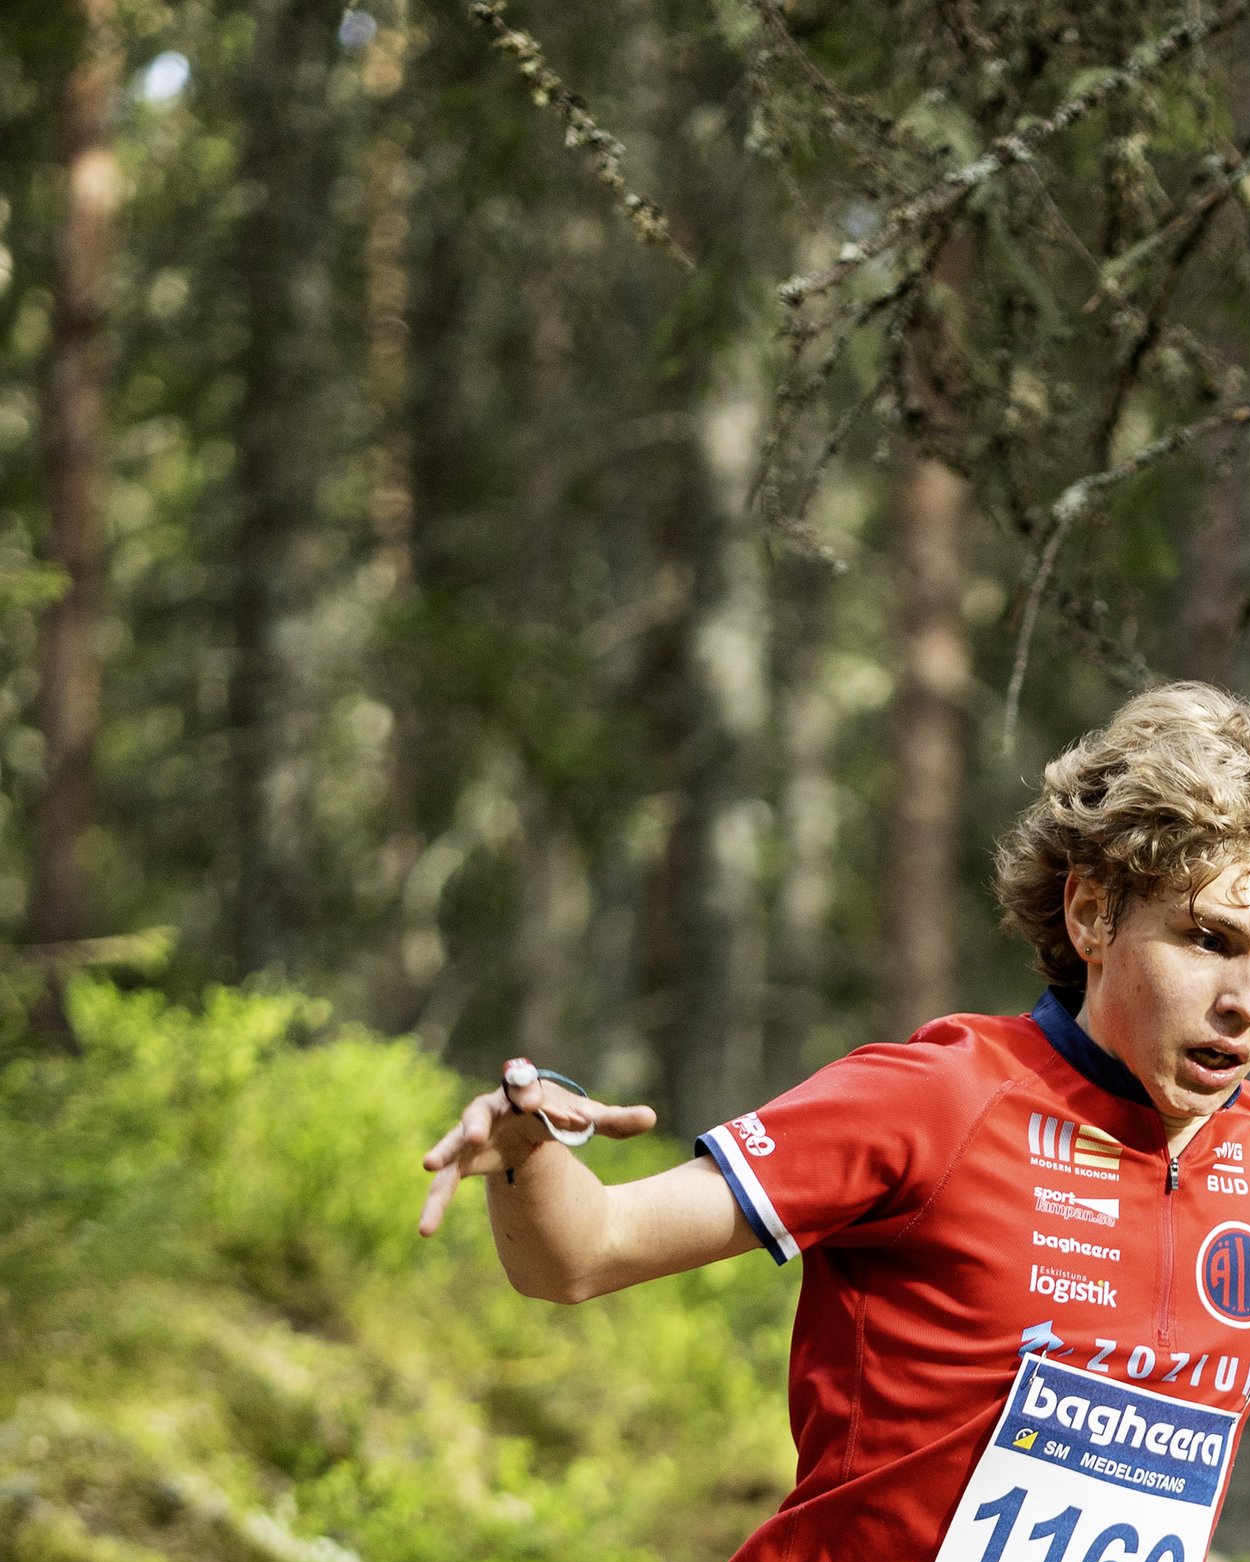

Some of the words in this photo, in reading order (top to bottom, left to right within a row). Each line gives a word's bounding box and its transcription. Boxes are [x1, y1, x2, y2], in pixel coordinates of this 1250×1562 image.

[1030, 1157, 1072, 1174] MODERN
[1074, 1167, 1120, 1182] EKONOMI
[1033, 1186, 1076, 1205] sport
[1207, 1174, 1249, 1196] BUD
[1032, 1230, 1121, 1262] bagheera
[1029, 1264, 1118, 1308] logistik
[1040, 1265, 1087, 1282] Eskilstuna
[1021, 1375, 1223, 1467] bagheera
[1044, 1440, 1070, 1461] SM
[1080, 1452, 1187, 1495] MEDELDISTANS
